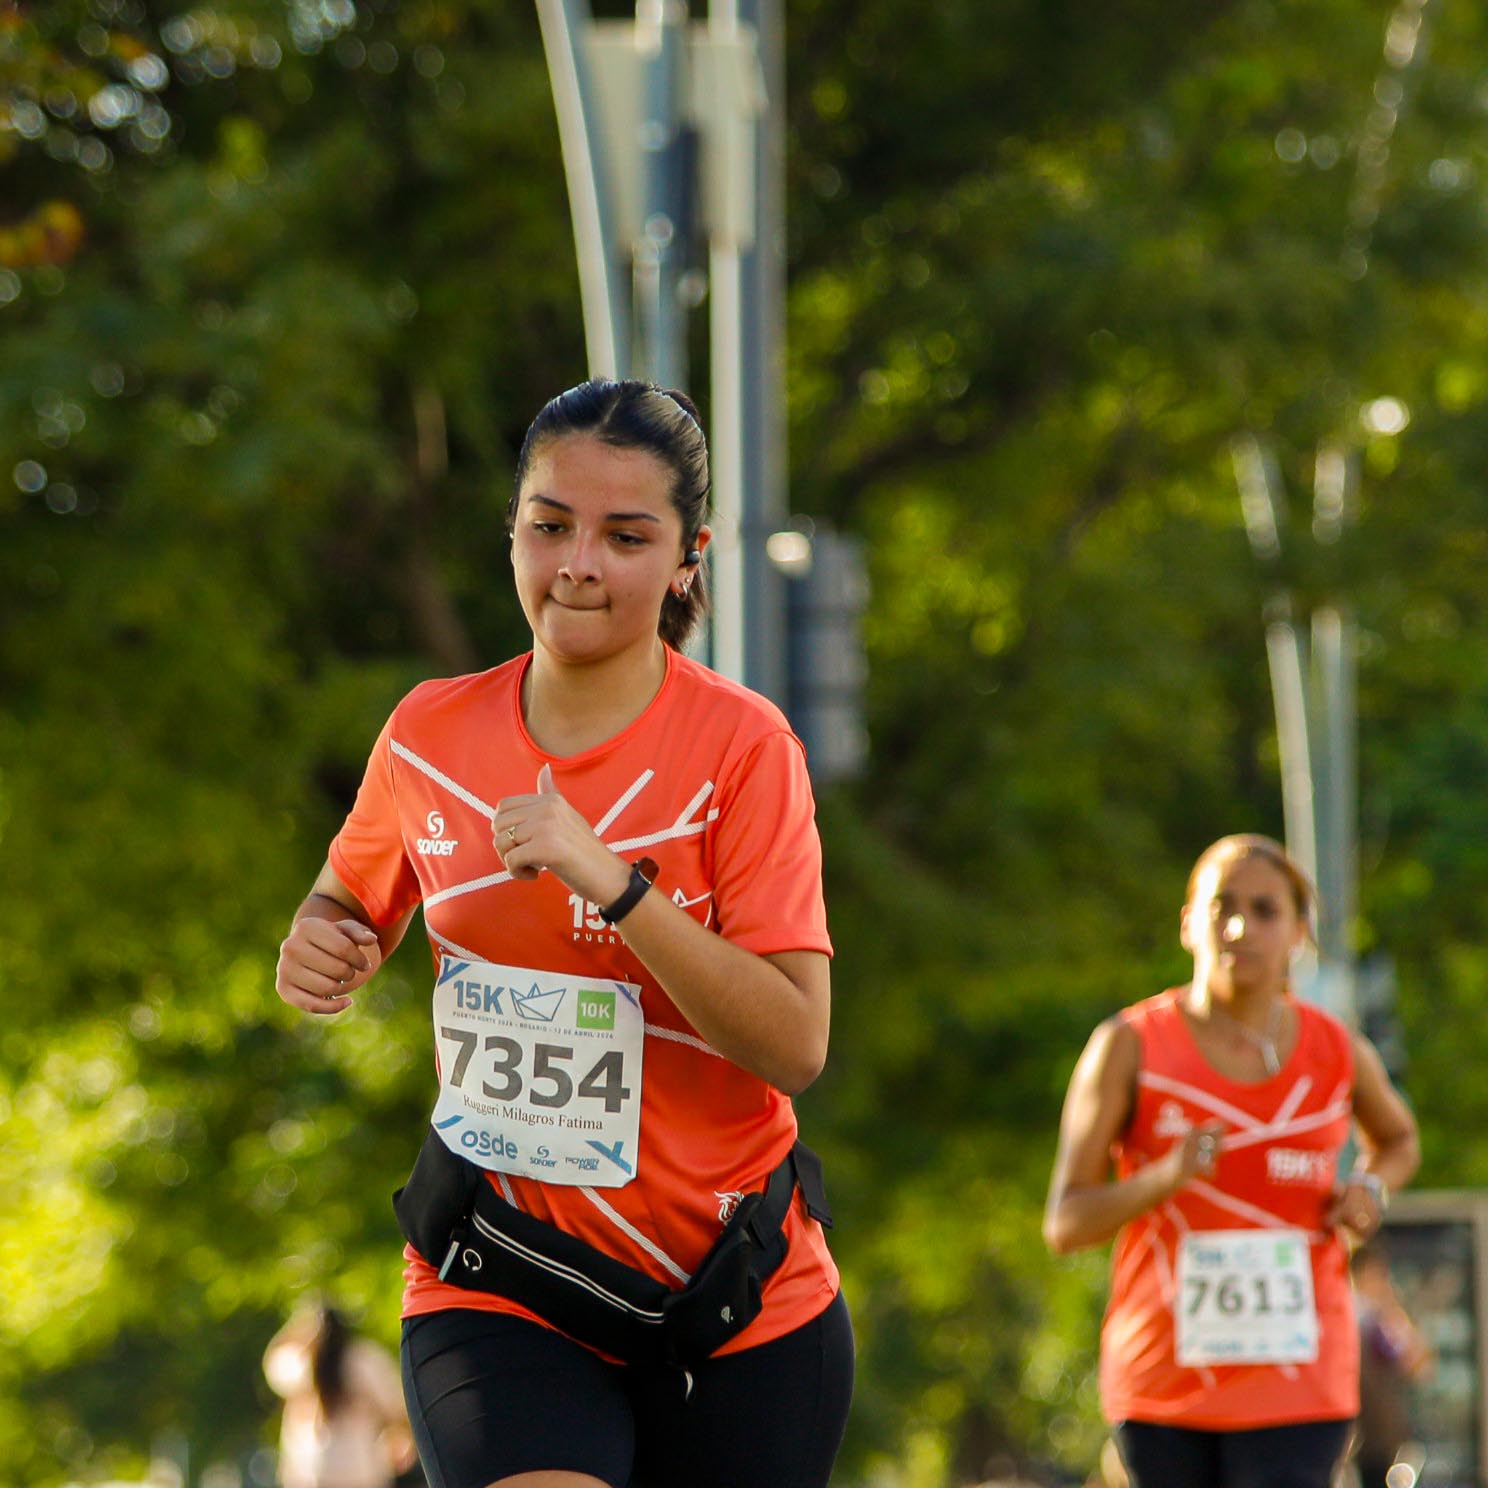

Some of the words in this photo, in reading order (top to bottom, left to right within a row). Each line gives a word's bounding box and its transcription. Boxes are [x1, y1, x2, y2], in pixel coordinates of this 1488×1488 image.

[568, 893, 617, 931] 15
[453, 980, 505, 1015] 15K
[581, 1002, 610, 1018] 10K
[440, 1026, 631, 1114] 7354
[463, 1094, 500, 1116] Ruggeri
[502, 1106, 554, 1126] Milagros
[559, 1115, 603, 1130] Fatima
[1185, 1274, 1305, 1317] 7613
